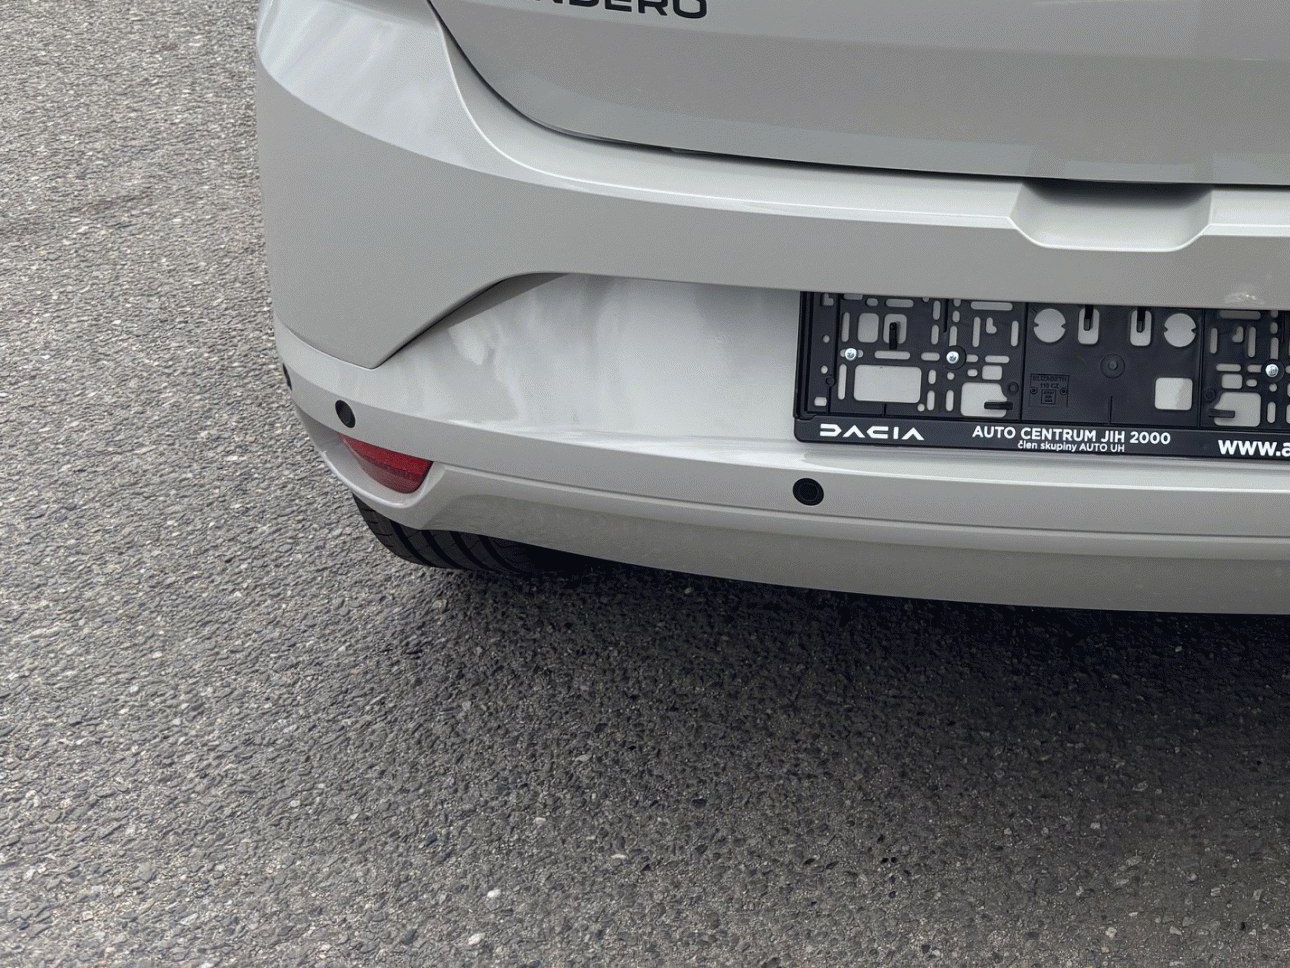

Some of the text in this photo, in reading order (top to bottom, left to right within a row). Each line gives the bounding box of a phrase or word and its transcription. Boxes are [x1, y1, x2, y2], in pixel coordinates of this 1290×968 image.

[819, 423, 925, 441] DACIA
[972, 425, 1171, 445] AUTO CENTRUM JIH 2000
[1017, 439, 1125, 453] člen skupiny AUTO UH
